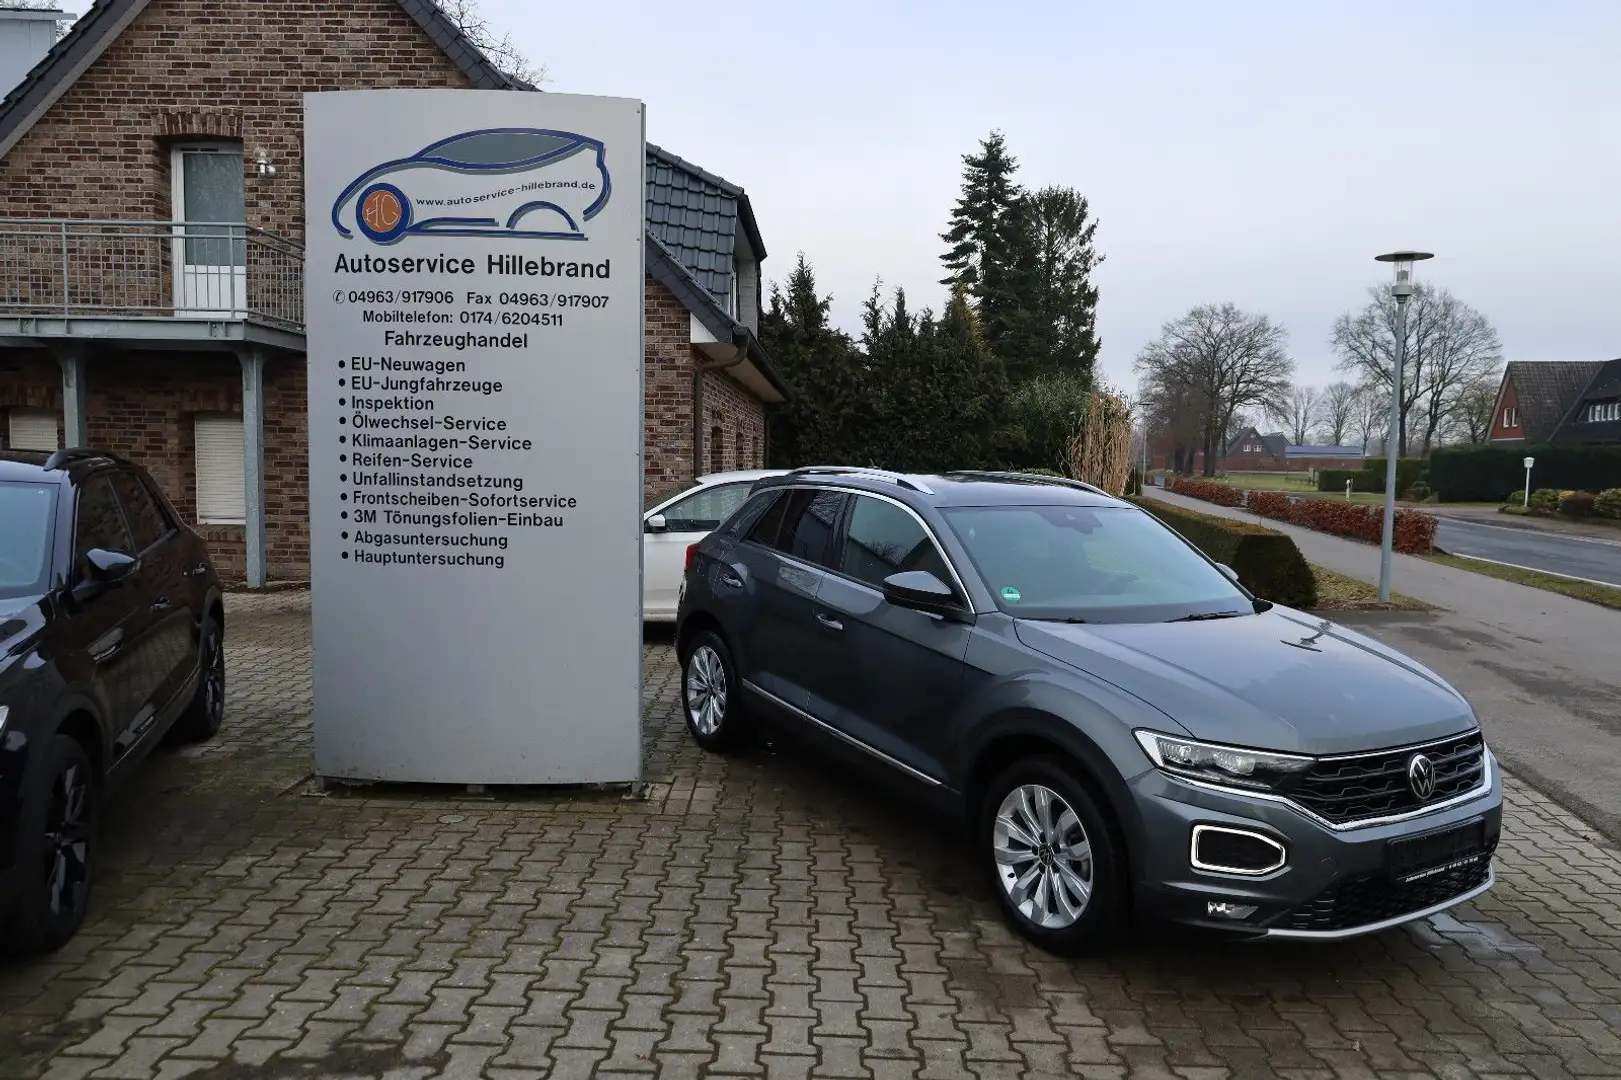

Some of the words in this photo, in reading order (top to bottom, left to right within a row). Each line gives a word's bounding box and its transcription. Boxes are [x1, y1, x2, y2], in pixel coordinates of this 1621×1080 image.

[415, 180, 596, 206] www.autoservice-hillebrand.de
[334, 252, 476, 275] Autoservice
[487, 254, 611, 279] Hillebrand
[348, 290, 455, 305] 04963/917906
[466, 291, 493, 305] Fax
[499, 292, 610, 309] 04963/917907
[362, 310, 453, 324] Mobiltelefon:
[459, 311, 563, 327] 0174/6204511
[384, 330, 528, 351] Fahrzeughandel
[351, 356, 466, 376] EU-Neuwagen
[351, 375, 503, 396] EU-Jungfahrzeuge
[351, 395, 434, 413] Inspektion
[352, 410, 507, 431] Ölwechsel-Service
[352, 433, 533, 453] Klimaanlagen-Service
[352, 452, 474, 469] Reifen-Service
[352, 471, 524, 492] Unfallinstandsetzung
[353, 491, 577, 509] Frontscheiben-Sofortservice
[353, 509, 377, 524] 3M
[383, 509, 564, 529] Tönungsfolien-Einbau
[354, 530, 508, 550] Abgasuntersuchung
[354, 548, 505, 569] Hauptuntersuchung
